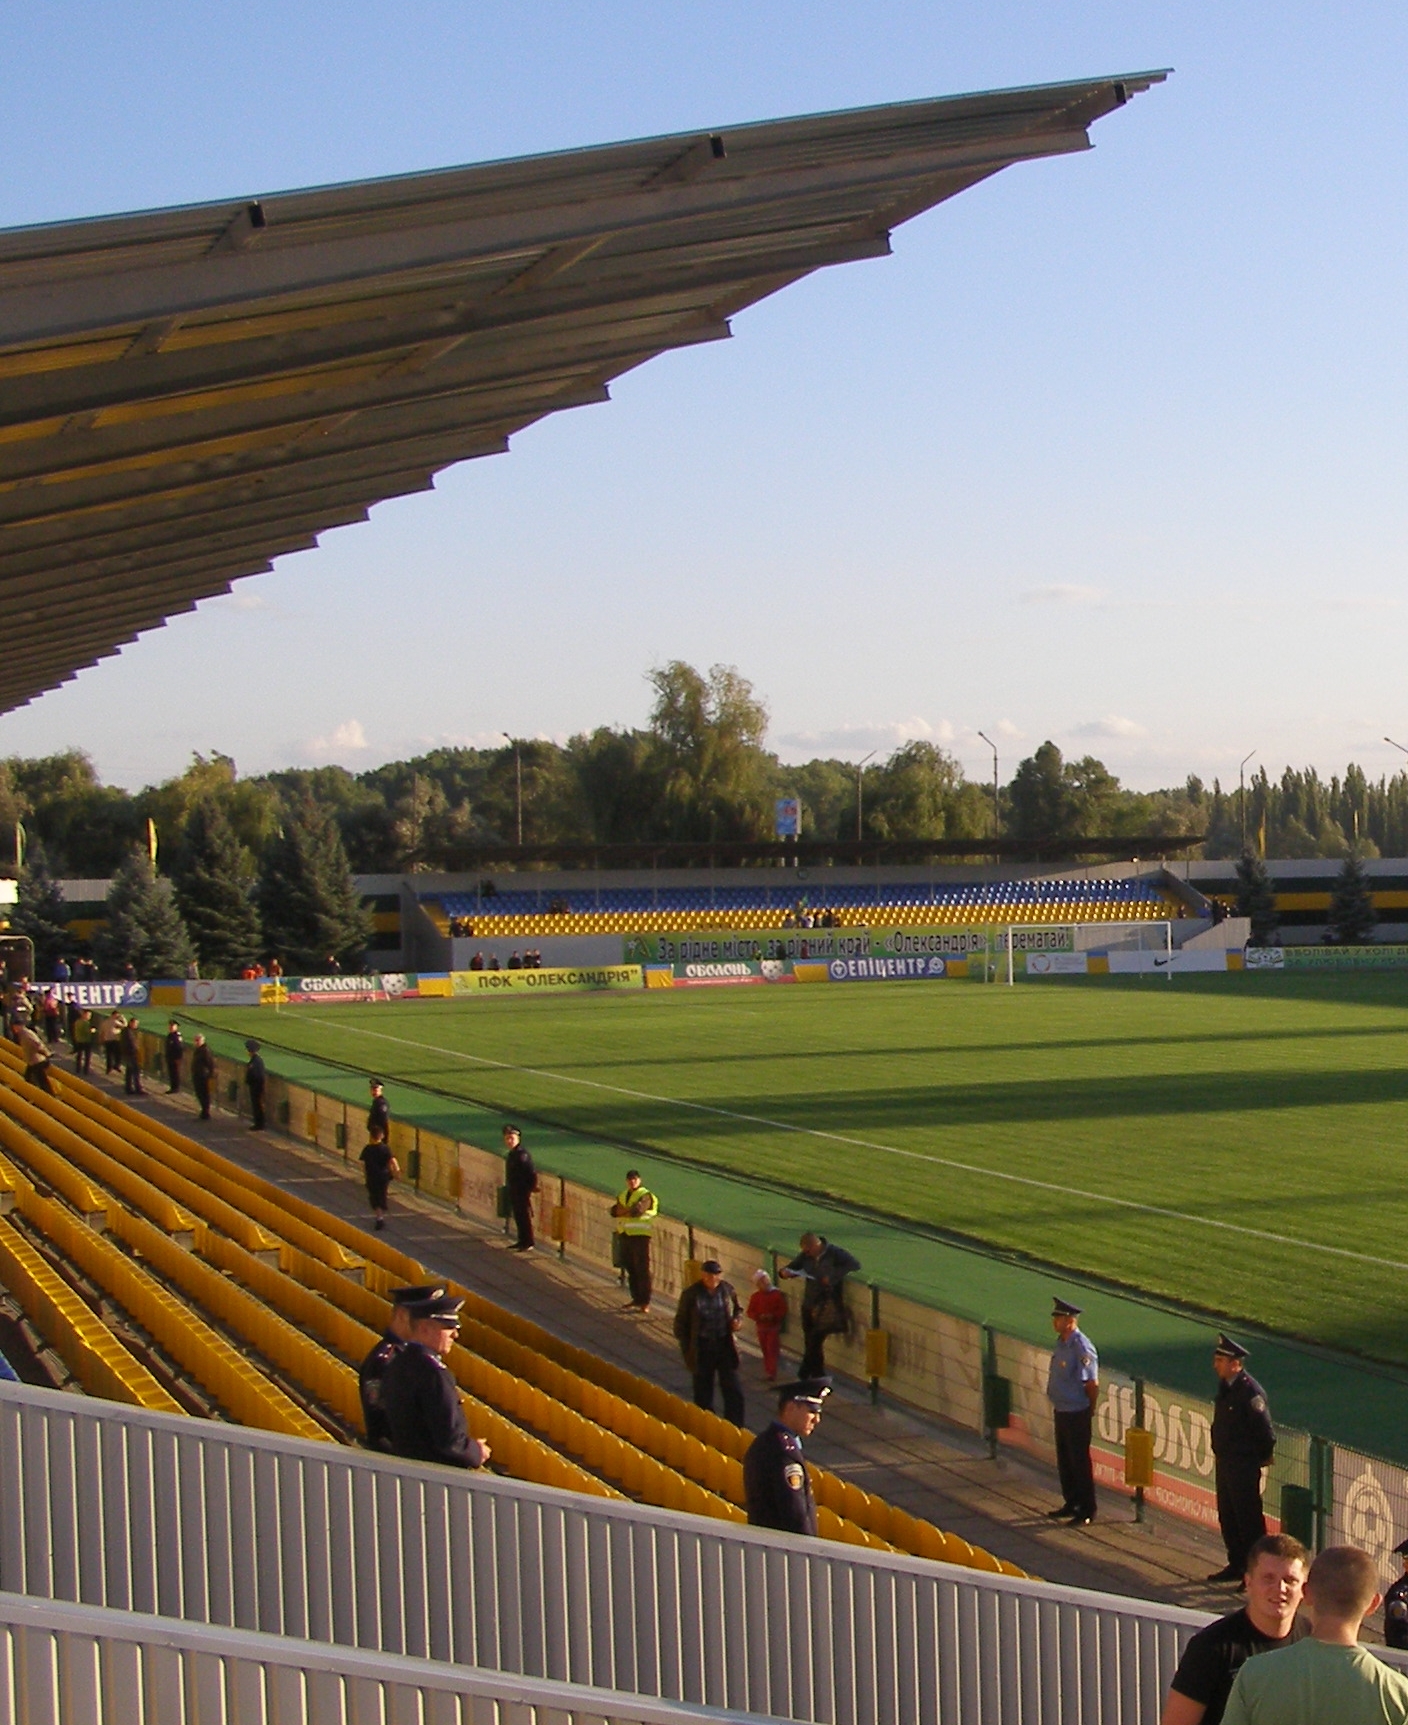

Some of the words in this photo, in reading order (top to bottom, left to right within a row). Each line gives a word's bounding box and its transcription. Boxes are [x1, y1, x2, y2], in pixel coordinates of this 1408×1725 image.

[658, 937, 675, 960] За
[680, 936, 718, 963] рідне
[839, 930, 870, 955] край
[849, 957, 926, 978] ЕПІЦЕНТР
[478, 975, 513, 989] ПФК
